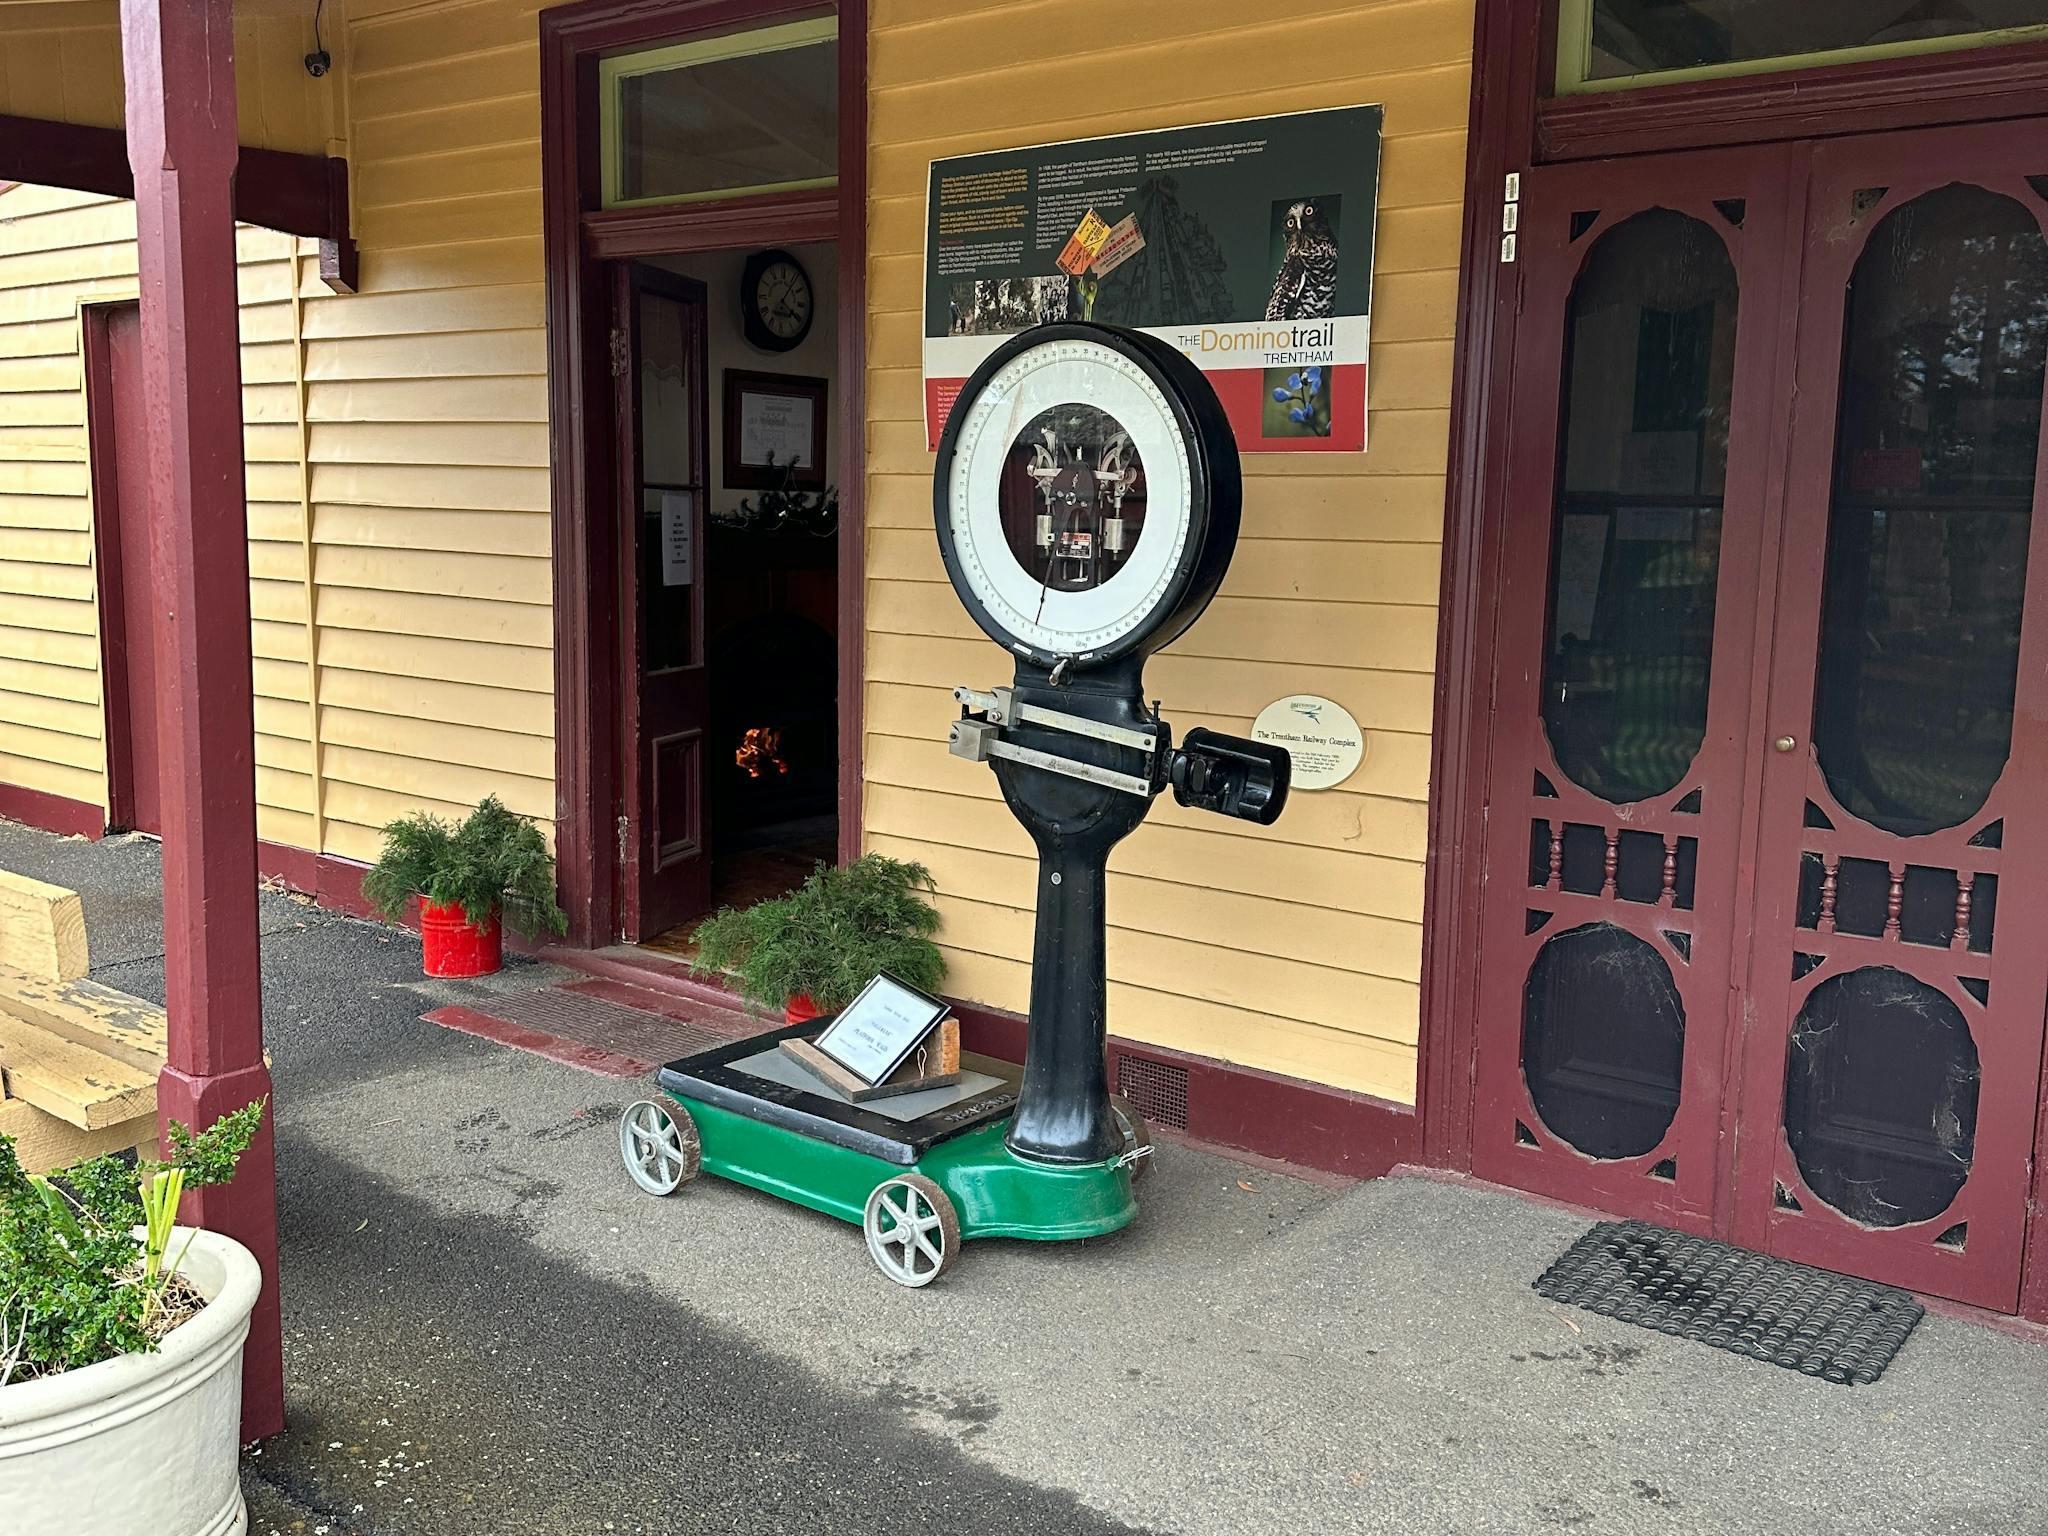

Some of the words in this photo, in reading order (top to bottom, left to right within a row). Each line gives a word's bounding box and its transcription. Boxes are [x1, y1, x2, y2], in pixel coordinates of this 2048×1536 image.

[1178, 335, 1200, 346] THE
[1264, 350, 1333, 364] TRENTHAM
[1258, 730, 1269, 739] The
[1271, 732, 1301, 742] Trentham
[1303, 735, 1327, 745] Railway
[1329, 737, 1356, 747] Complex
